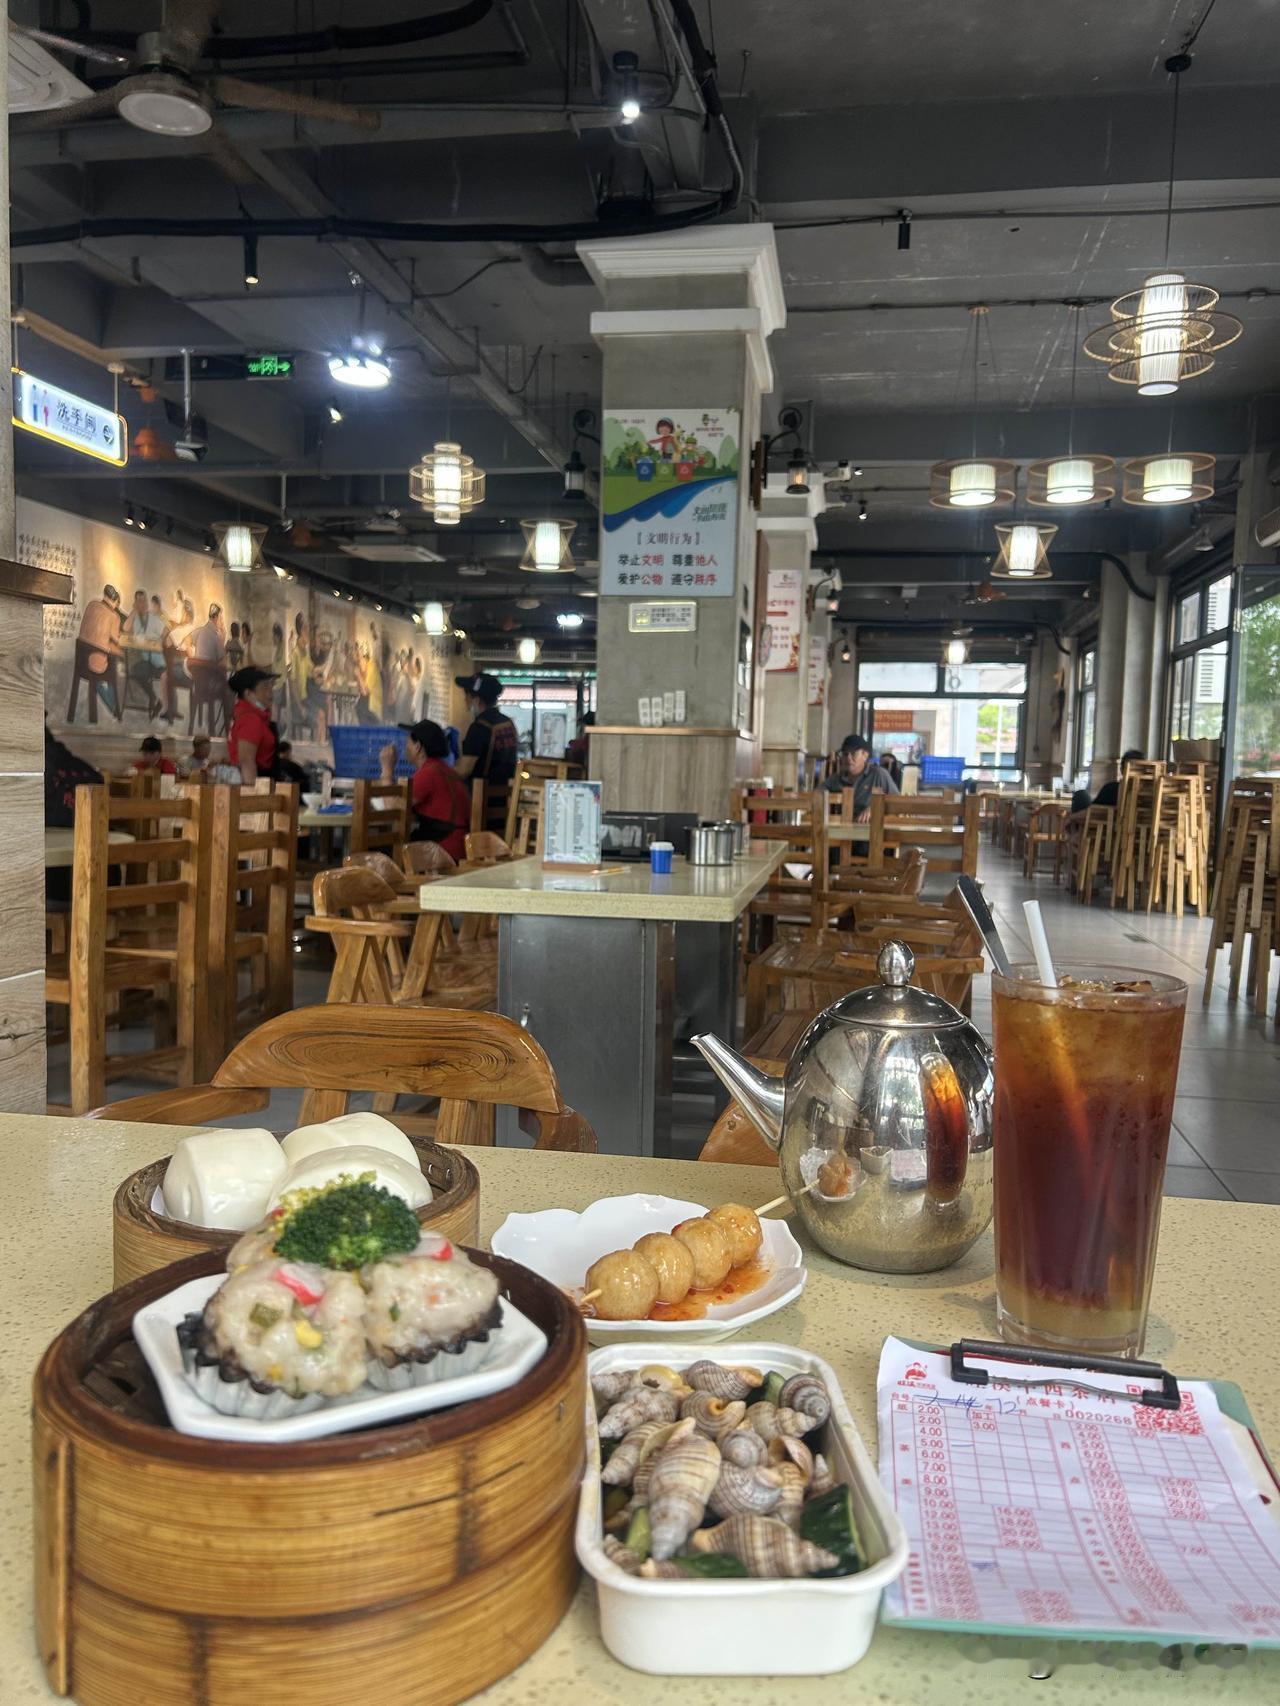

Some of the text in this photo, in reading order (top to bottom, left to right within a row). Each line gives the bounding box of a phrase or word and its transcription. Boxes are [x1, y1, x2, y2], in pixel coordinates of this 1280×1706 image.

[618, 554, 718, 566] 举止文明 尊重他人
[618, 573, 717, 586] 爱护公物 遵守秩序
[918, 1405, 940, 1415] 2.00
[919, 1415, 941, 1425] 2.00
[1065, 1409, 1133, 1425] 0020268
[973, 1421, 995, 1431] 3.00
[920, 1427, 942, 1437] 4.00
[921, 1438, 943, 1448] 5.00
[922, 1450, 945, 1460] 6.00
[922, 1462, 946, 1473] 7.00
[924, 1474, 947, 1486] 8.00
[924, 1487, 949, 1497] 9.00
[923, 1498, 955, 1509] 10.00
